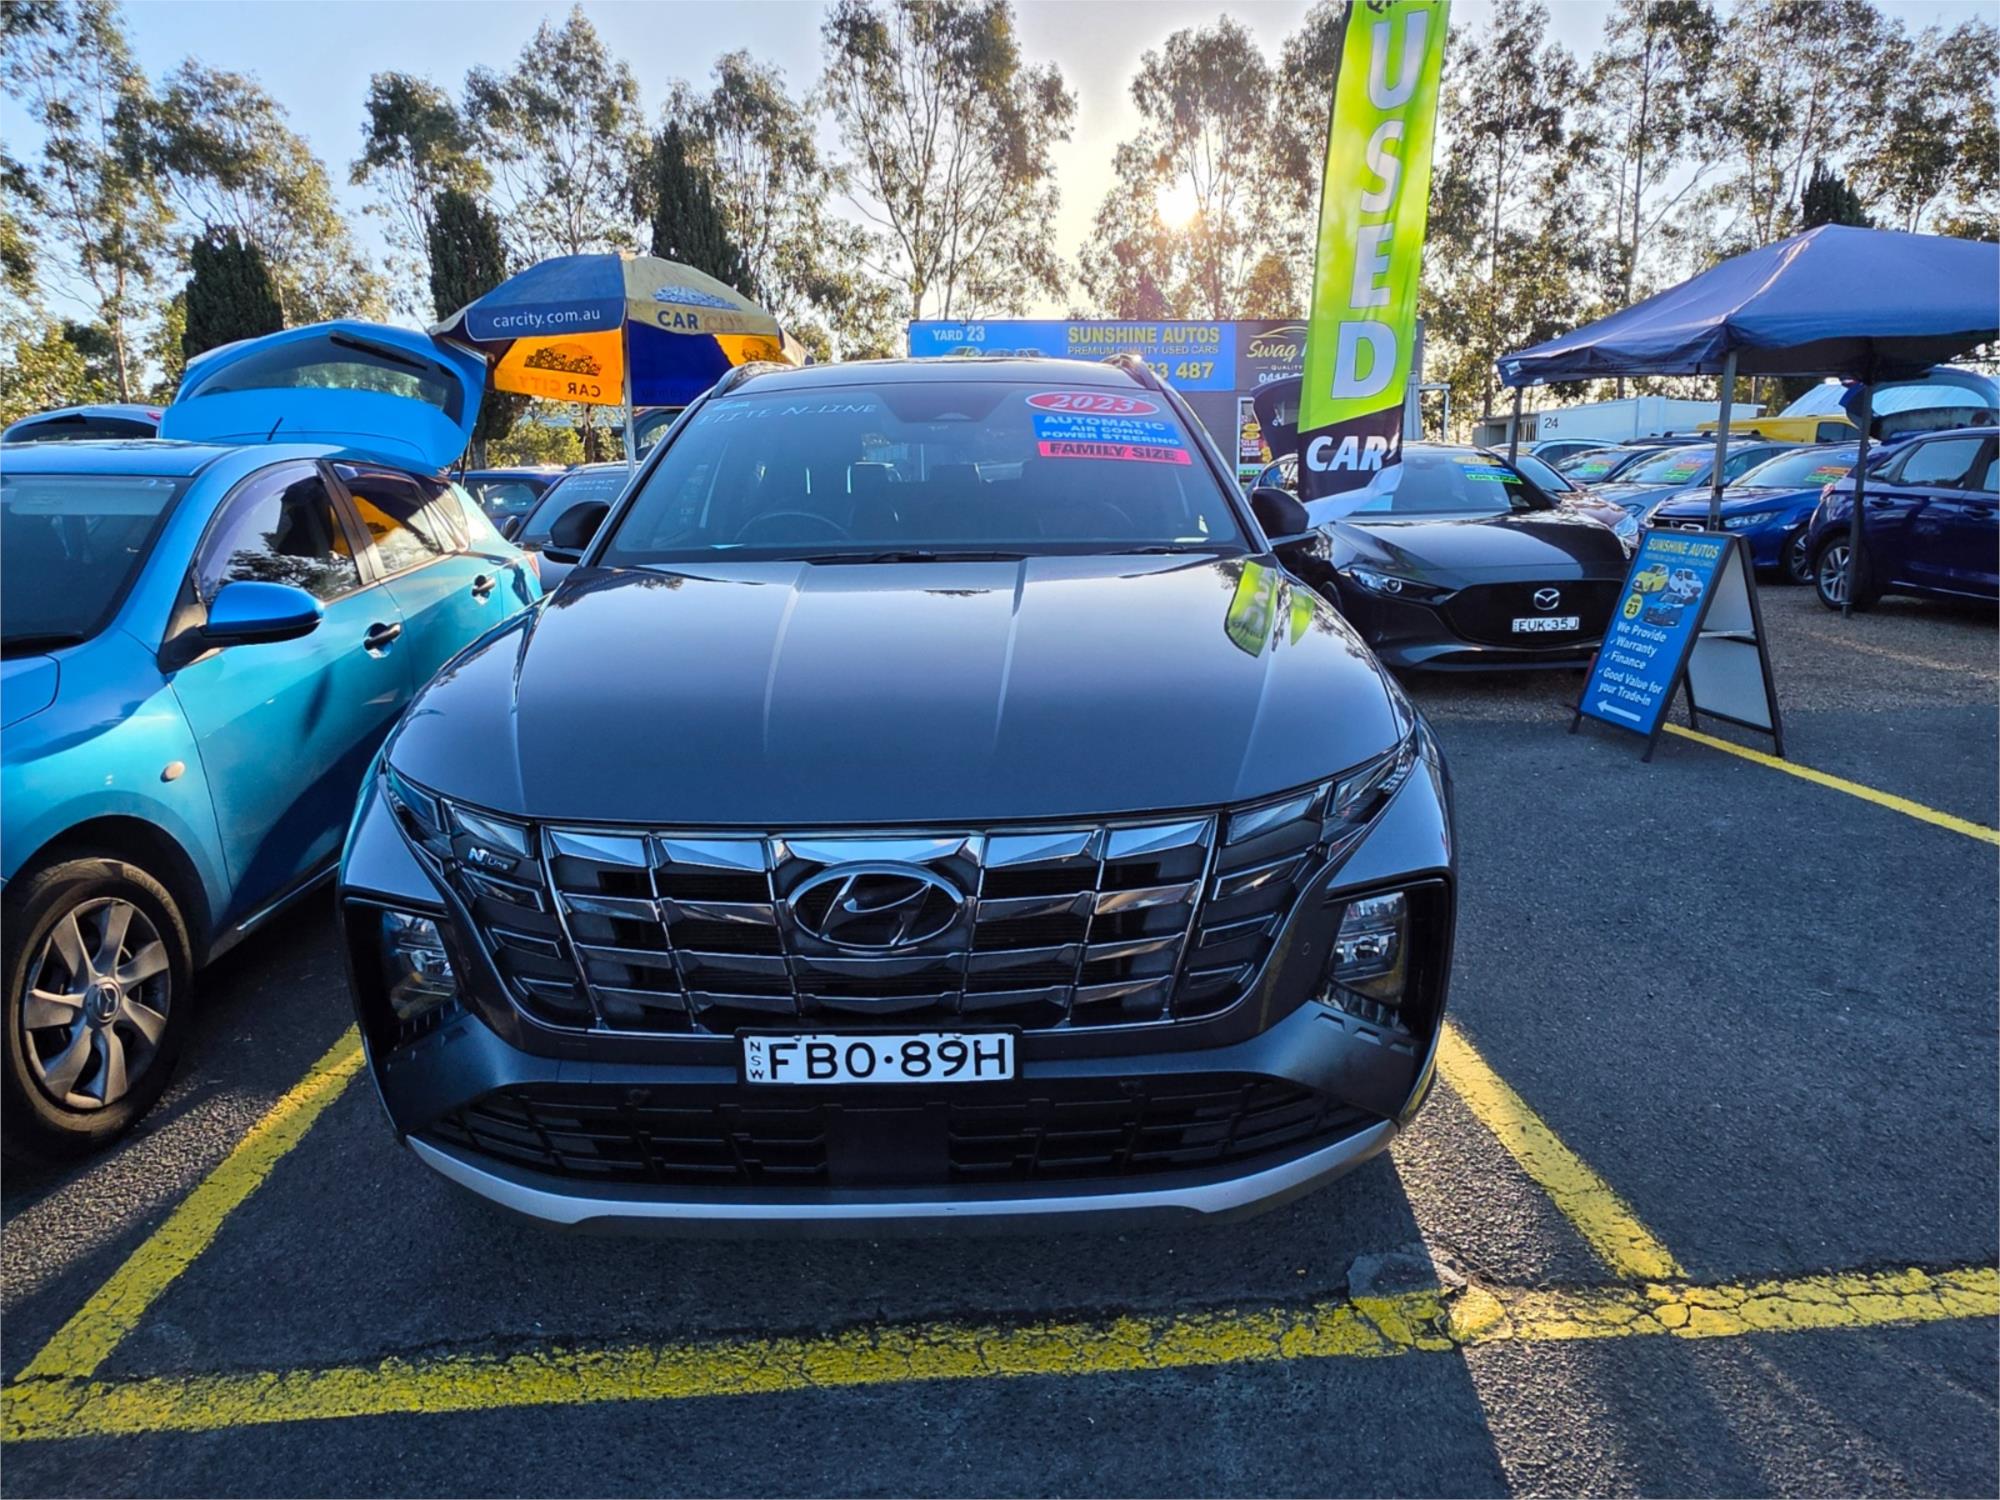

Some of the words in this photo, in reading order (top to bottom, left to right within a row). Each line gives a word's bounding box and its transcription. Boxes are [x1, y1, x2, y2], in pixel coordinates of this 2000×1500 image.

[1331, 9, 1429, 400] USED
[493, 309, 601, 328] carcity.com.au
[657, 310, 699, 329] CAR
[932, 329, 963, 341] YARD
[966, 325, 986, 342] 23
[1067, 326, 1158, 344] SUNSHINE
[1162, 326, 1221, 343] AUTOS
[1067, 346, 1114, 355] PREMIUM
[1161, 346, 1189, 355] USED
[1191, 345, 1219, 354] CARS
[1246, 339, 1297, 362] Swag
[1175, 361, 1214, 379] 487
[1050, 394, 1137, 412] 2023
[1044, 415, 1166, 431] AUTOMATIC
[1070, 425, 1097, 433] AIR
[1101, 426, 1149, 435] COND.
[1544, 416, 1559, 429] 24
[1041, 431, 1098, 440] POWER
[1101, 434, 1180, 445] STEERING
[1050, 443, 1127, 457] FAMILY
[1132, 446, 1178, 461] SIZE
[1689, 543, 1721, 559] AUTOS
[1625, 602, 1639, 615] 23
[1617, 621, 1631, 634] We
[1631, 624, 1668, 642] Provide
[1615, 636, 1658, 658] Warranty
[1610, 650, 1647, 670] Finance
[1603, 667, 1625, 682] Good
[1625, 673, 1649, 690] Value
[1648, 681, 1664, 695] for
[1597, 682, 1618, 694] your
[1617, 686, 1652, 707] Trade-in
